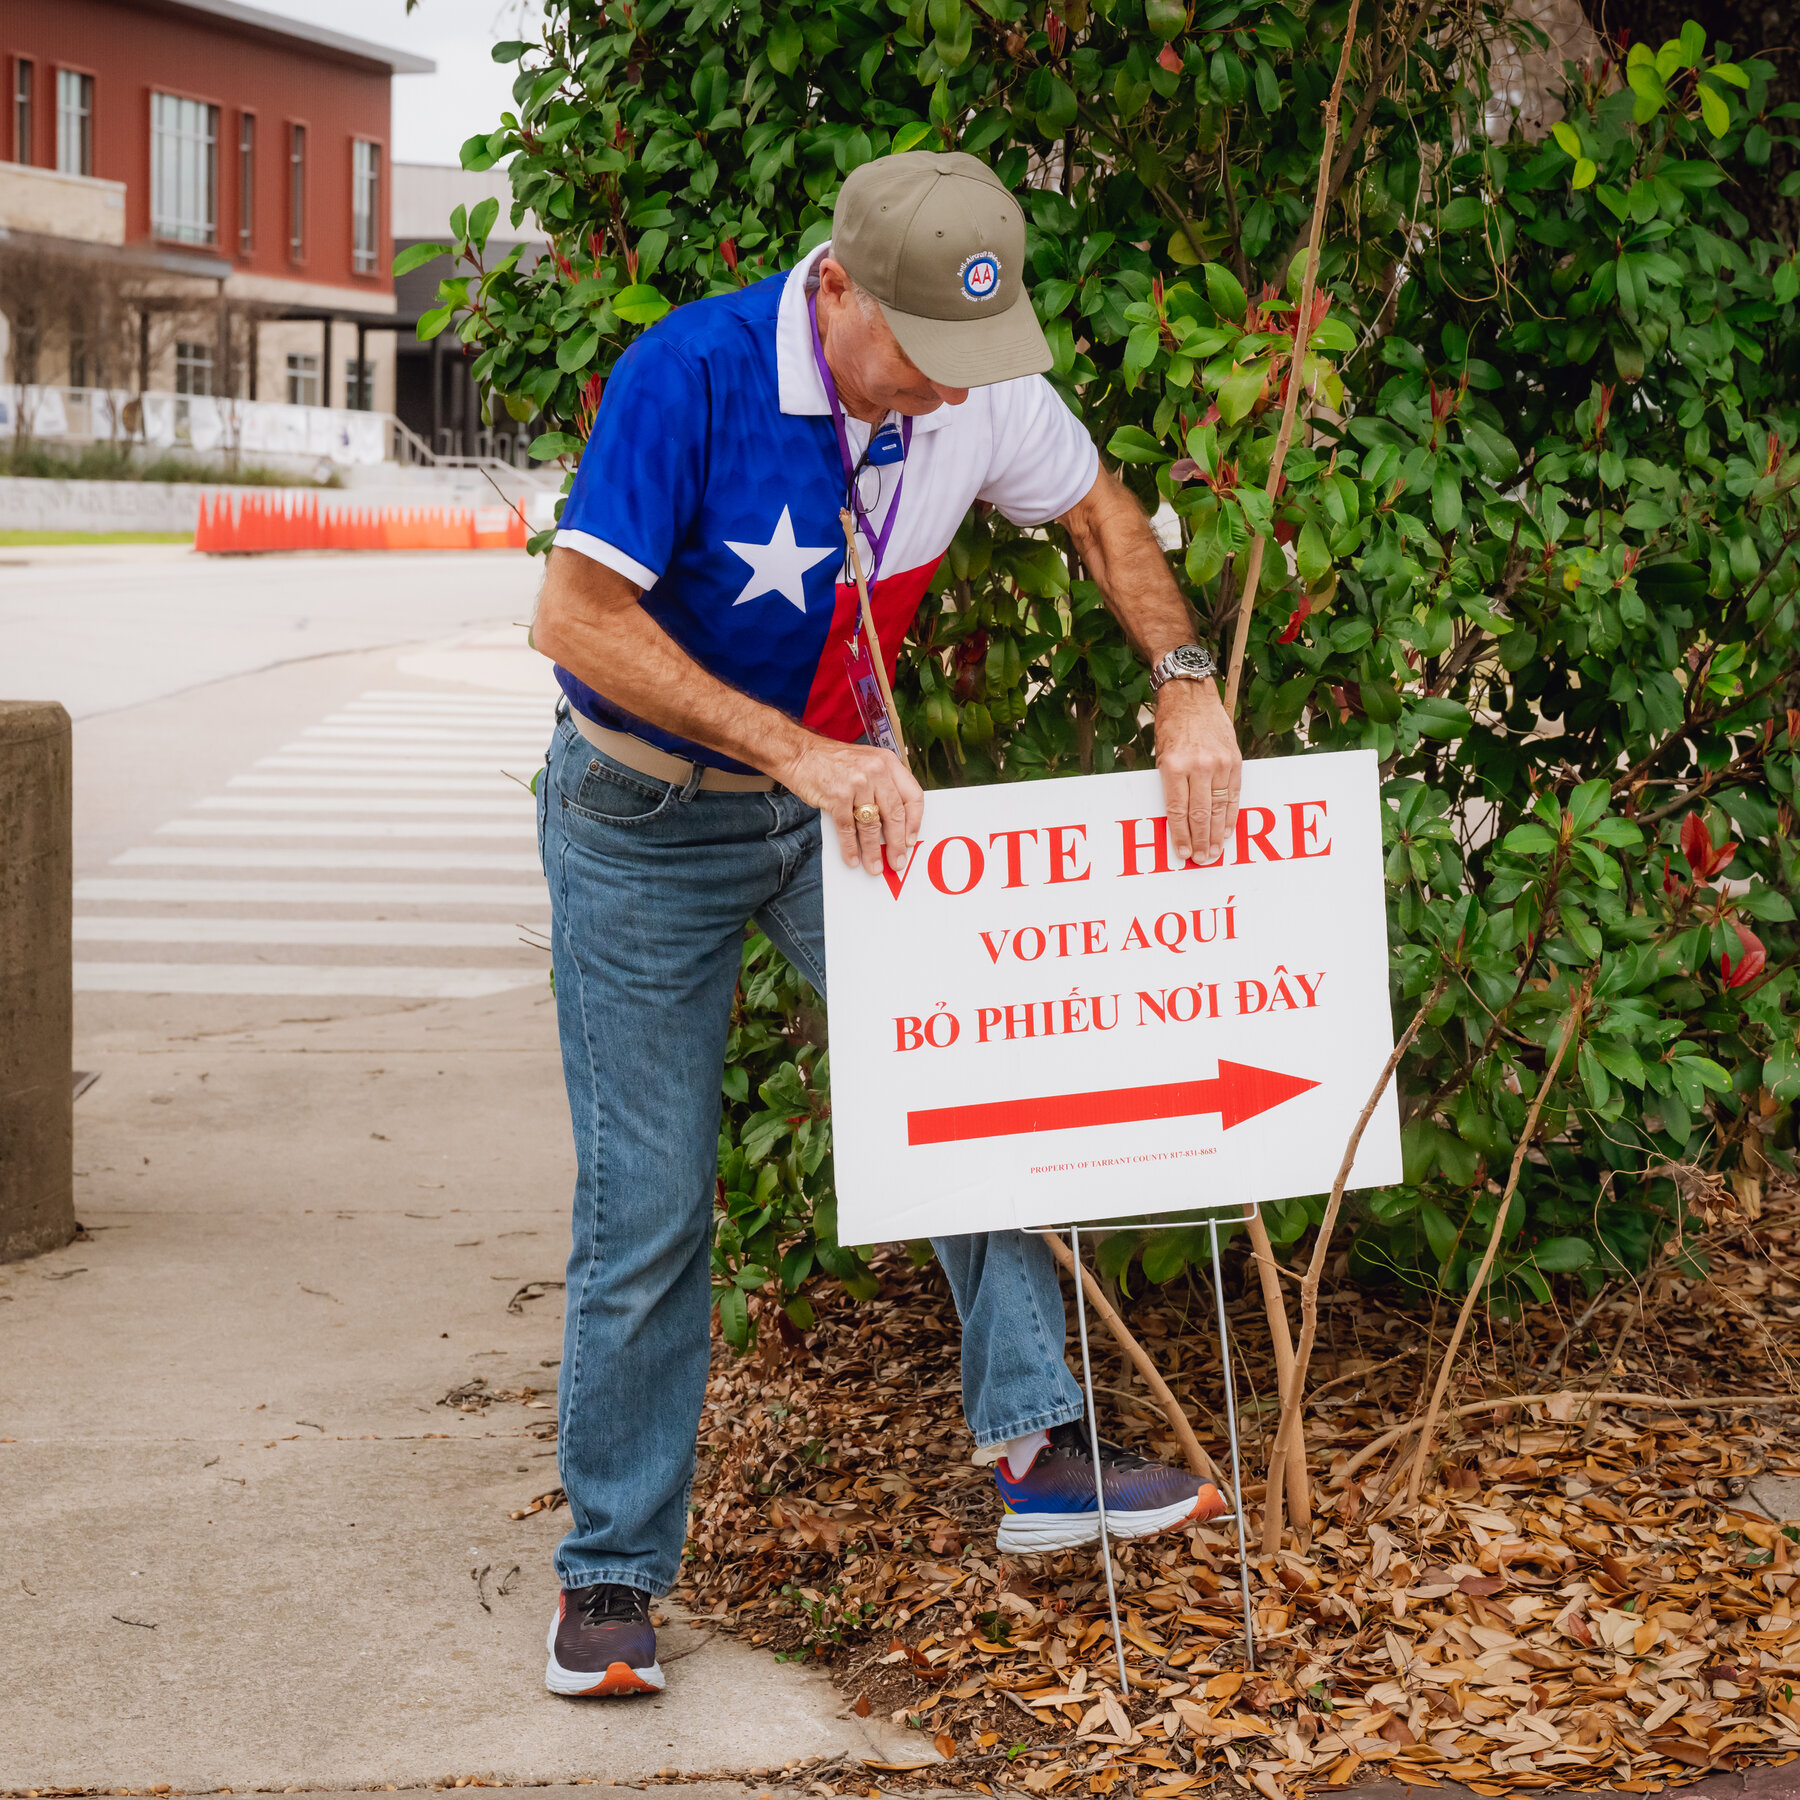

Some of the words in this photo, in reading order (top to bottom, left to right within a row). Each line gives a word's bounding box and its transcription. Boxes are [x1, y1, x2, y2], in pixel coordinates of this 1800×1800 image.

[879, 824, 1092, 902] VOTE
[977, 919, 1109, 965] VOTE
[1119, 895, 1239, 954] AQUÍ
[891, 1000, 960, 1053] BỎ
[973, 986, 1121, 1044] PHIẾU
[1135, 981, 1223, 1027] NƠI
[1233, 964, 1327, 1016] ĐÂY
[1030, 1162, 1076, 1174] PROPERTY
[1077, 1160, 1089, 1170] OF
[1090, 1156, 1133, 1168] TARRANT
[1132, 1152, 1169, 1163] COUNTY
[1170, 1147, 1218, 1159] 817-831-8683
